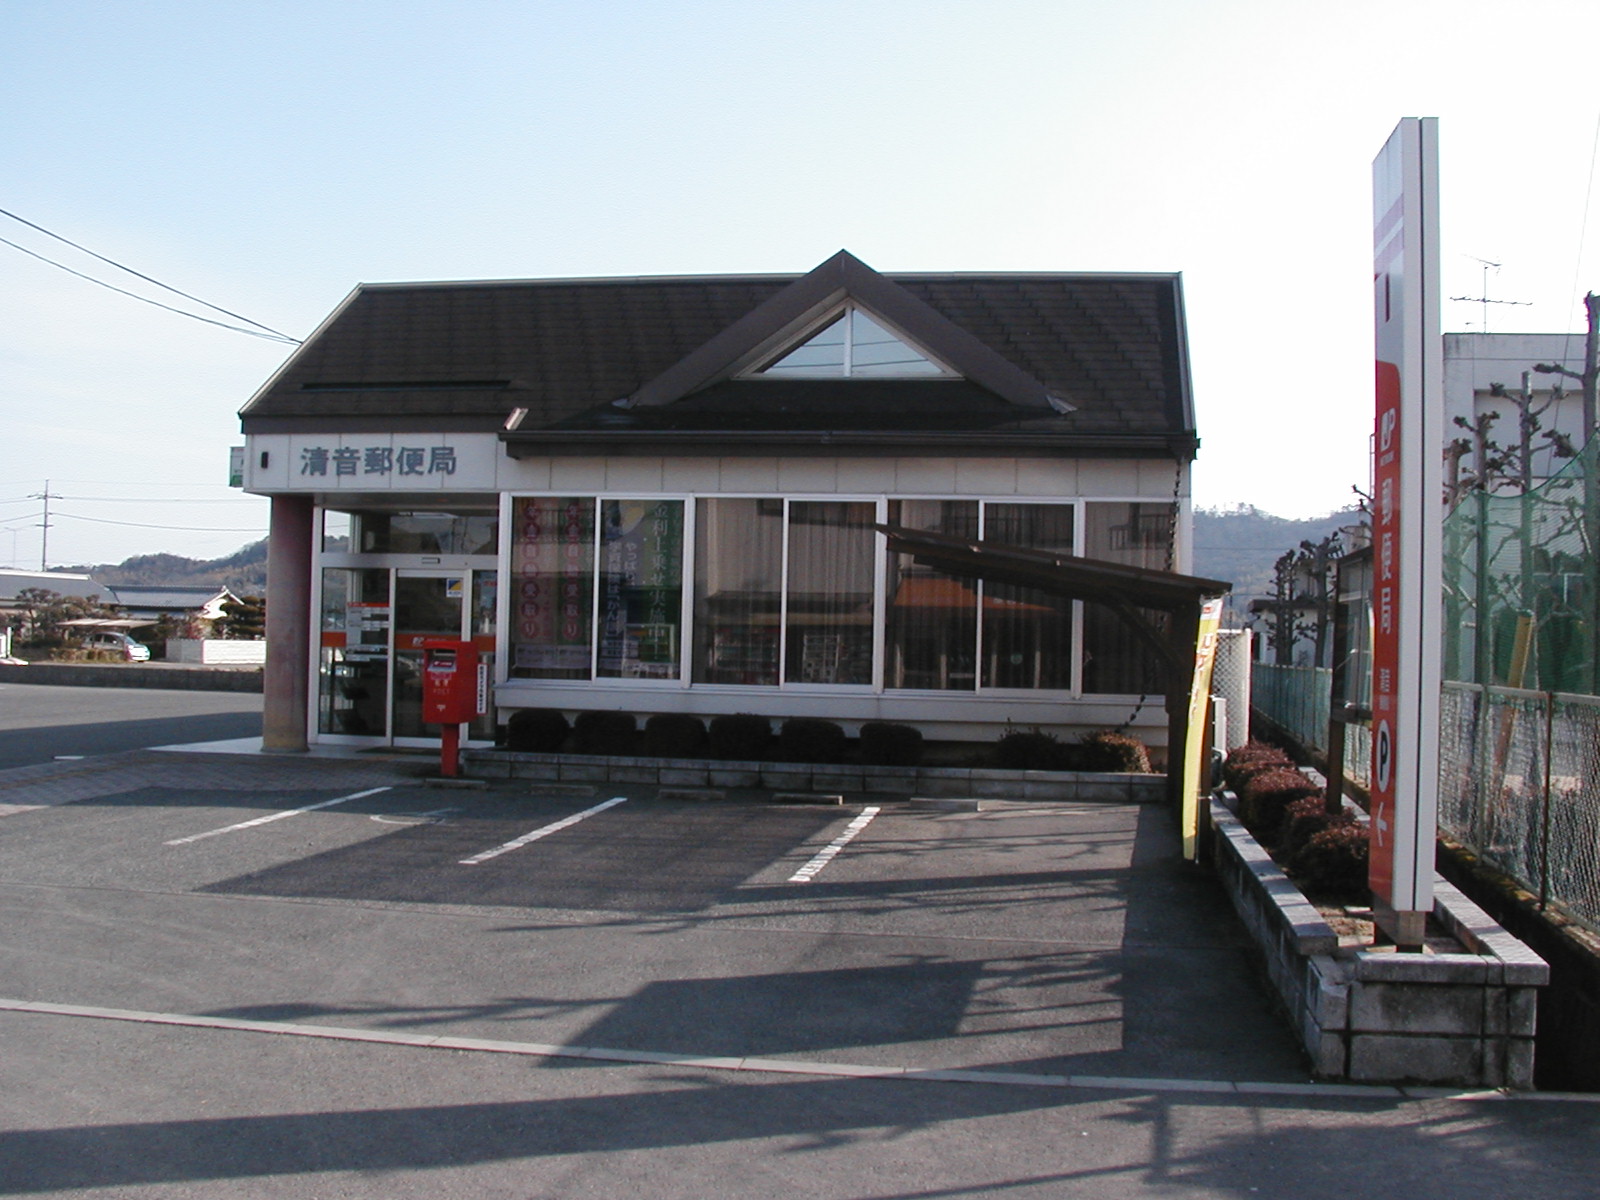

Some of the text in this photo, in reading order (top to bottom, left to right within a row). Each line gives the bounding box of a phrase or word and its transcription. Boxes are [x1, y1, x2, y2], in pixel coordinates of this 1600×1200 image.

[300, 446, 457, 476] 清音郵便局
[649, 504, 667, 660] 金利上乗せ実施中
[1380, 731, 1388, 781] P
